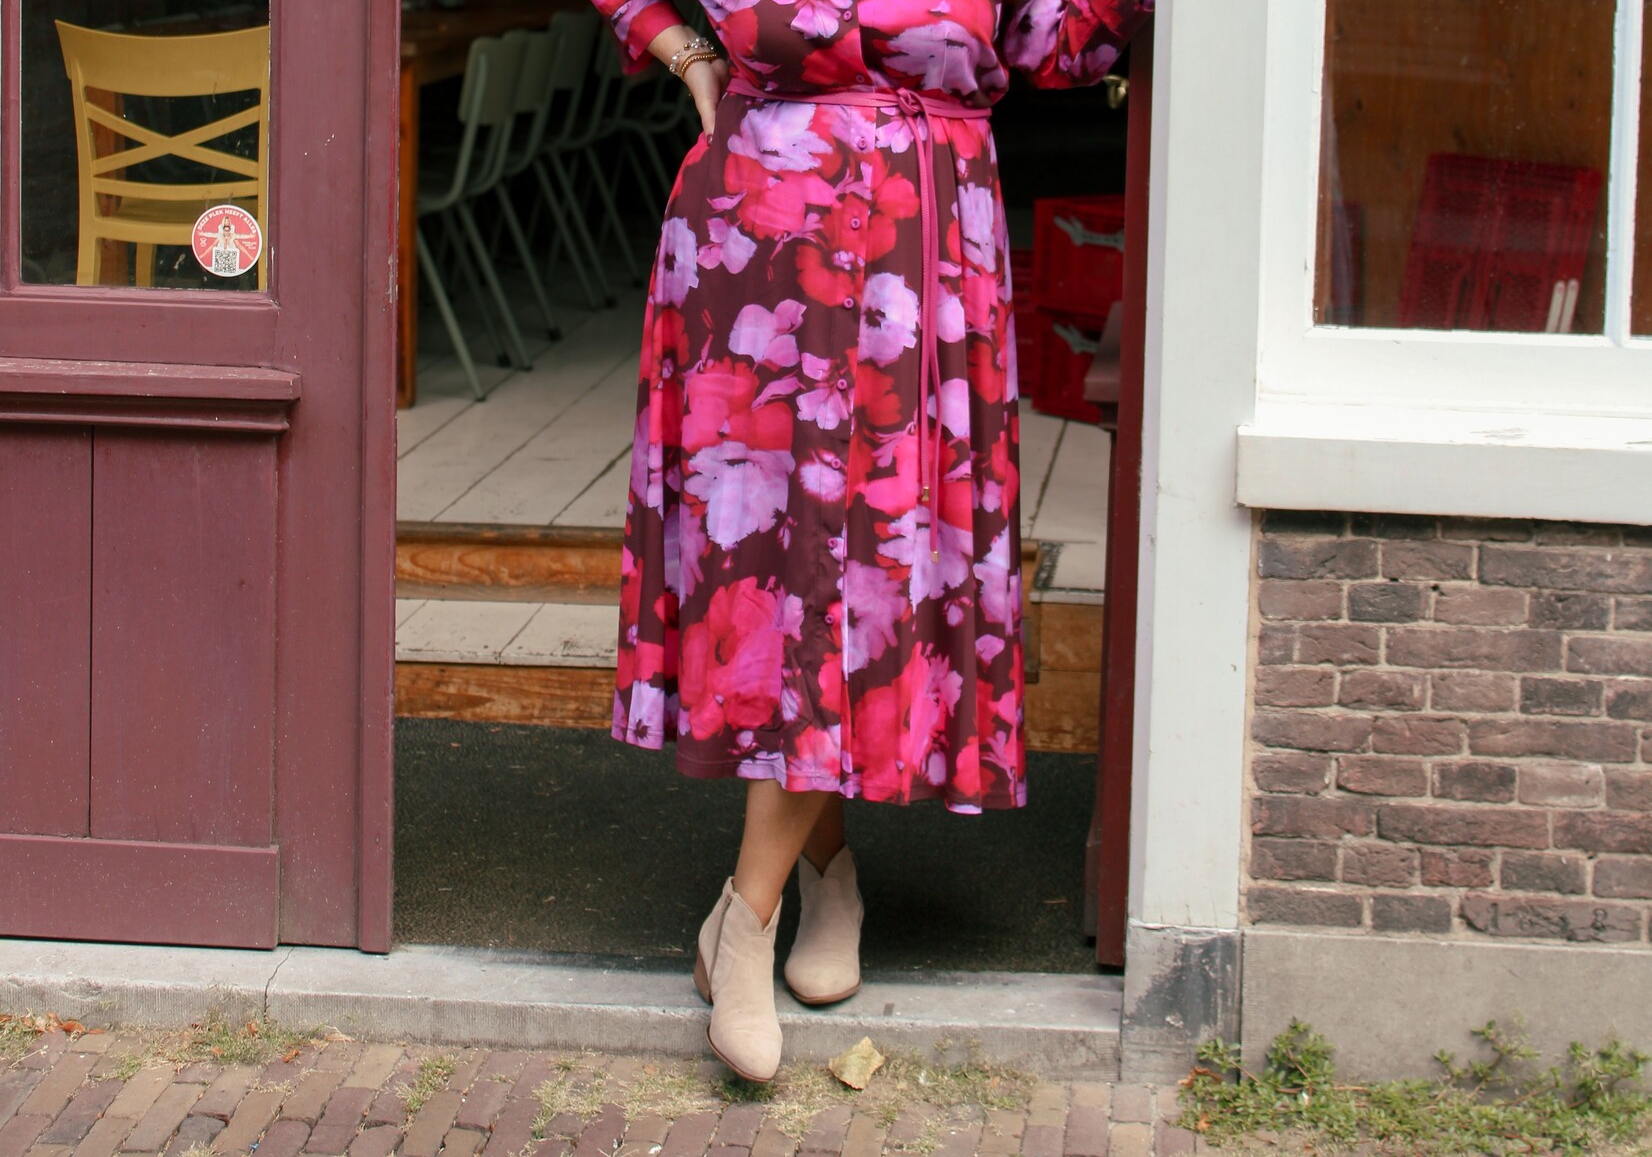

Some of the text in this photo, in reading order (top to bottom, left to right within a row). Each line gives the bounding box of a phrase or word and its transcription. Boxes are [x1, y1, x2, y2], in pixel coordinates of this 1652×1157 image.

[197, 209, 257, 233] DEZE PLEK HEEFT ALLES
